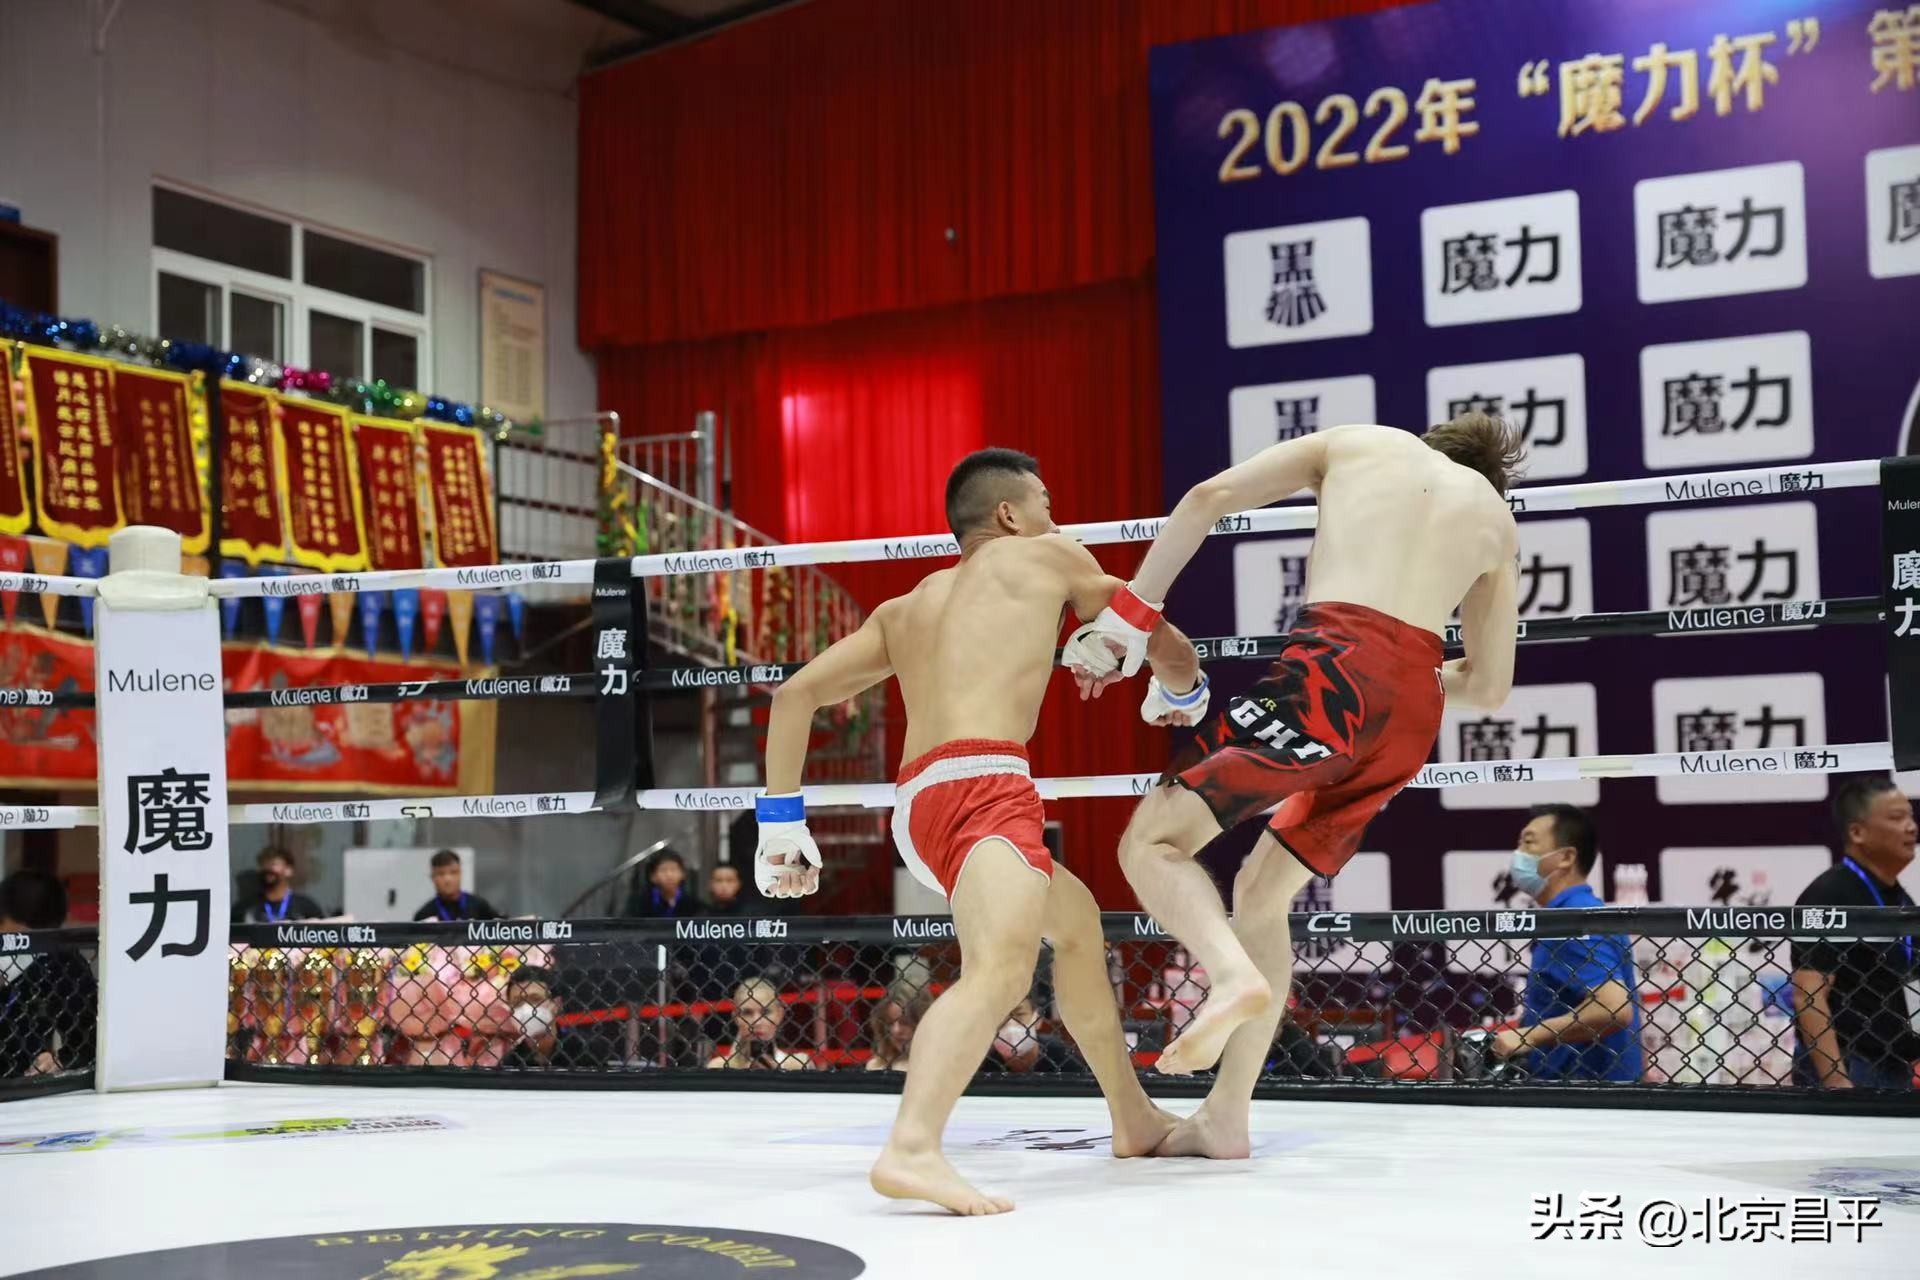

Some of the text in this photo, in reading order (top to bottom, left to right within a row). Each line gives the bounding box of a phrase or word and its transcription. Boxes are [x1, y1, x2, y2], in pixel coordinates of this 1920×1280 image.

[1217, 77, 1480, 183] 2022年
[1655, 196, 1785, 270] 魔力
[1440, 225, 1561, 294] 魔力
[1661, 367, 1792, 437] 魔力
[1665, 471, 1824, 501] Mulene 魔力
[664, 550, 776, 573] Mulene 魔力
[884, 540, 959, 560] Mulene
[457, 564, 562, 585] Mulene 魔力
[1667, 539, 1798, 606] 魔力
[261, 579, 322, 596] Mulene
[595, 586, 627, 597] Mulene
[1668, 600, 1827, 630] Mulene 魔力
[1221, 637, 1259, 656] 魔力
[597, 627, 628, 697] 魔力
[107, 668, 216, 693] Mulene
[465, 675, 571, 695] Mulene 魔力
[672, 664, 784, 687] Mulene 魔力
[271, 684, 369, 706] Mulene 魔力
[1680, 750, 1840, 774] Mulene 魔力
[1410, 763, 1534, 786] ulene 魔力
[272, 803, 371, 821] Mulene 魔力
[462, 795, 567, 816] Mulene 魔力
[675, 792, 745, 809] Mulene
[123, 767, 213, 962] 魔力
[675, 919, 788, 940] Mulene 魔力
[892, 918, 955, 939] Mulen
[1392, 911, 1537, 935] Mulene 魔力
[1686, 907, 1848, 931] Mulene 魔力
[277, 925, 377, 944] Mulene 魔力
[467, 921, 573, 941] Mulene 魔力
